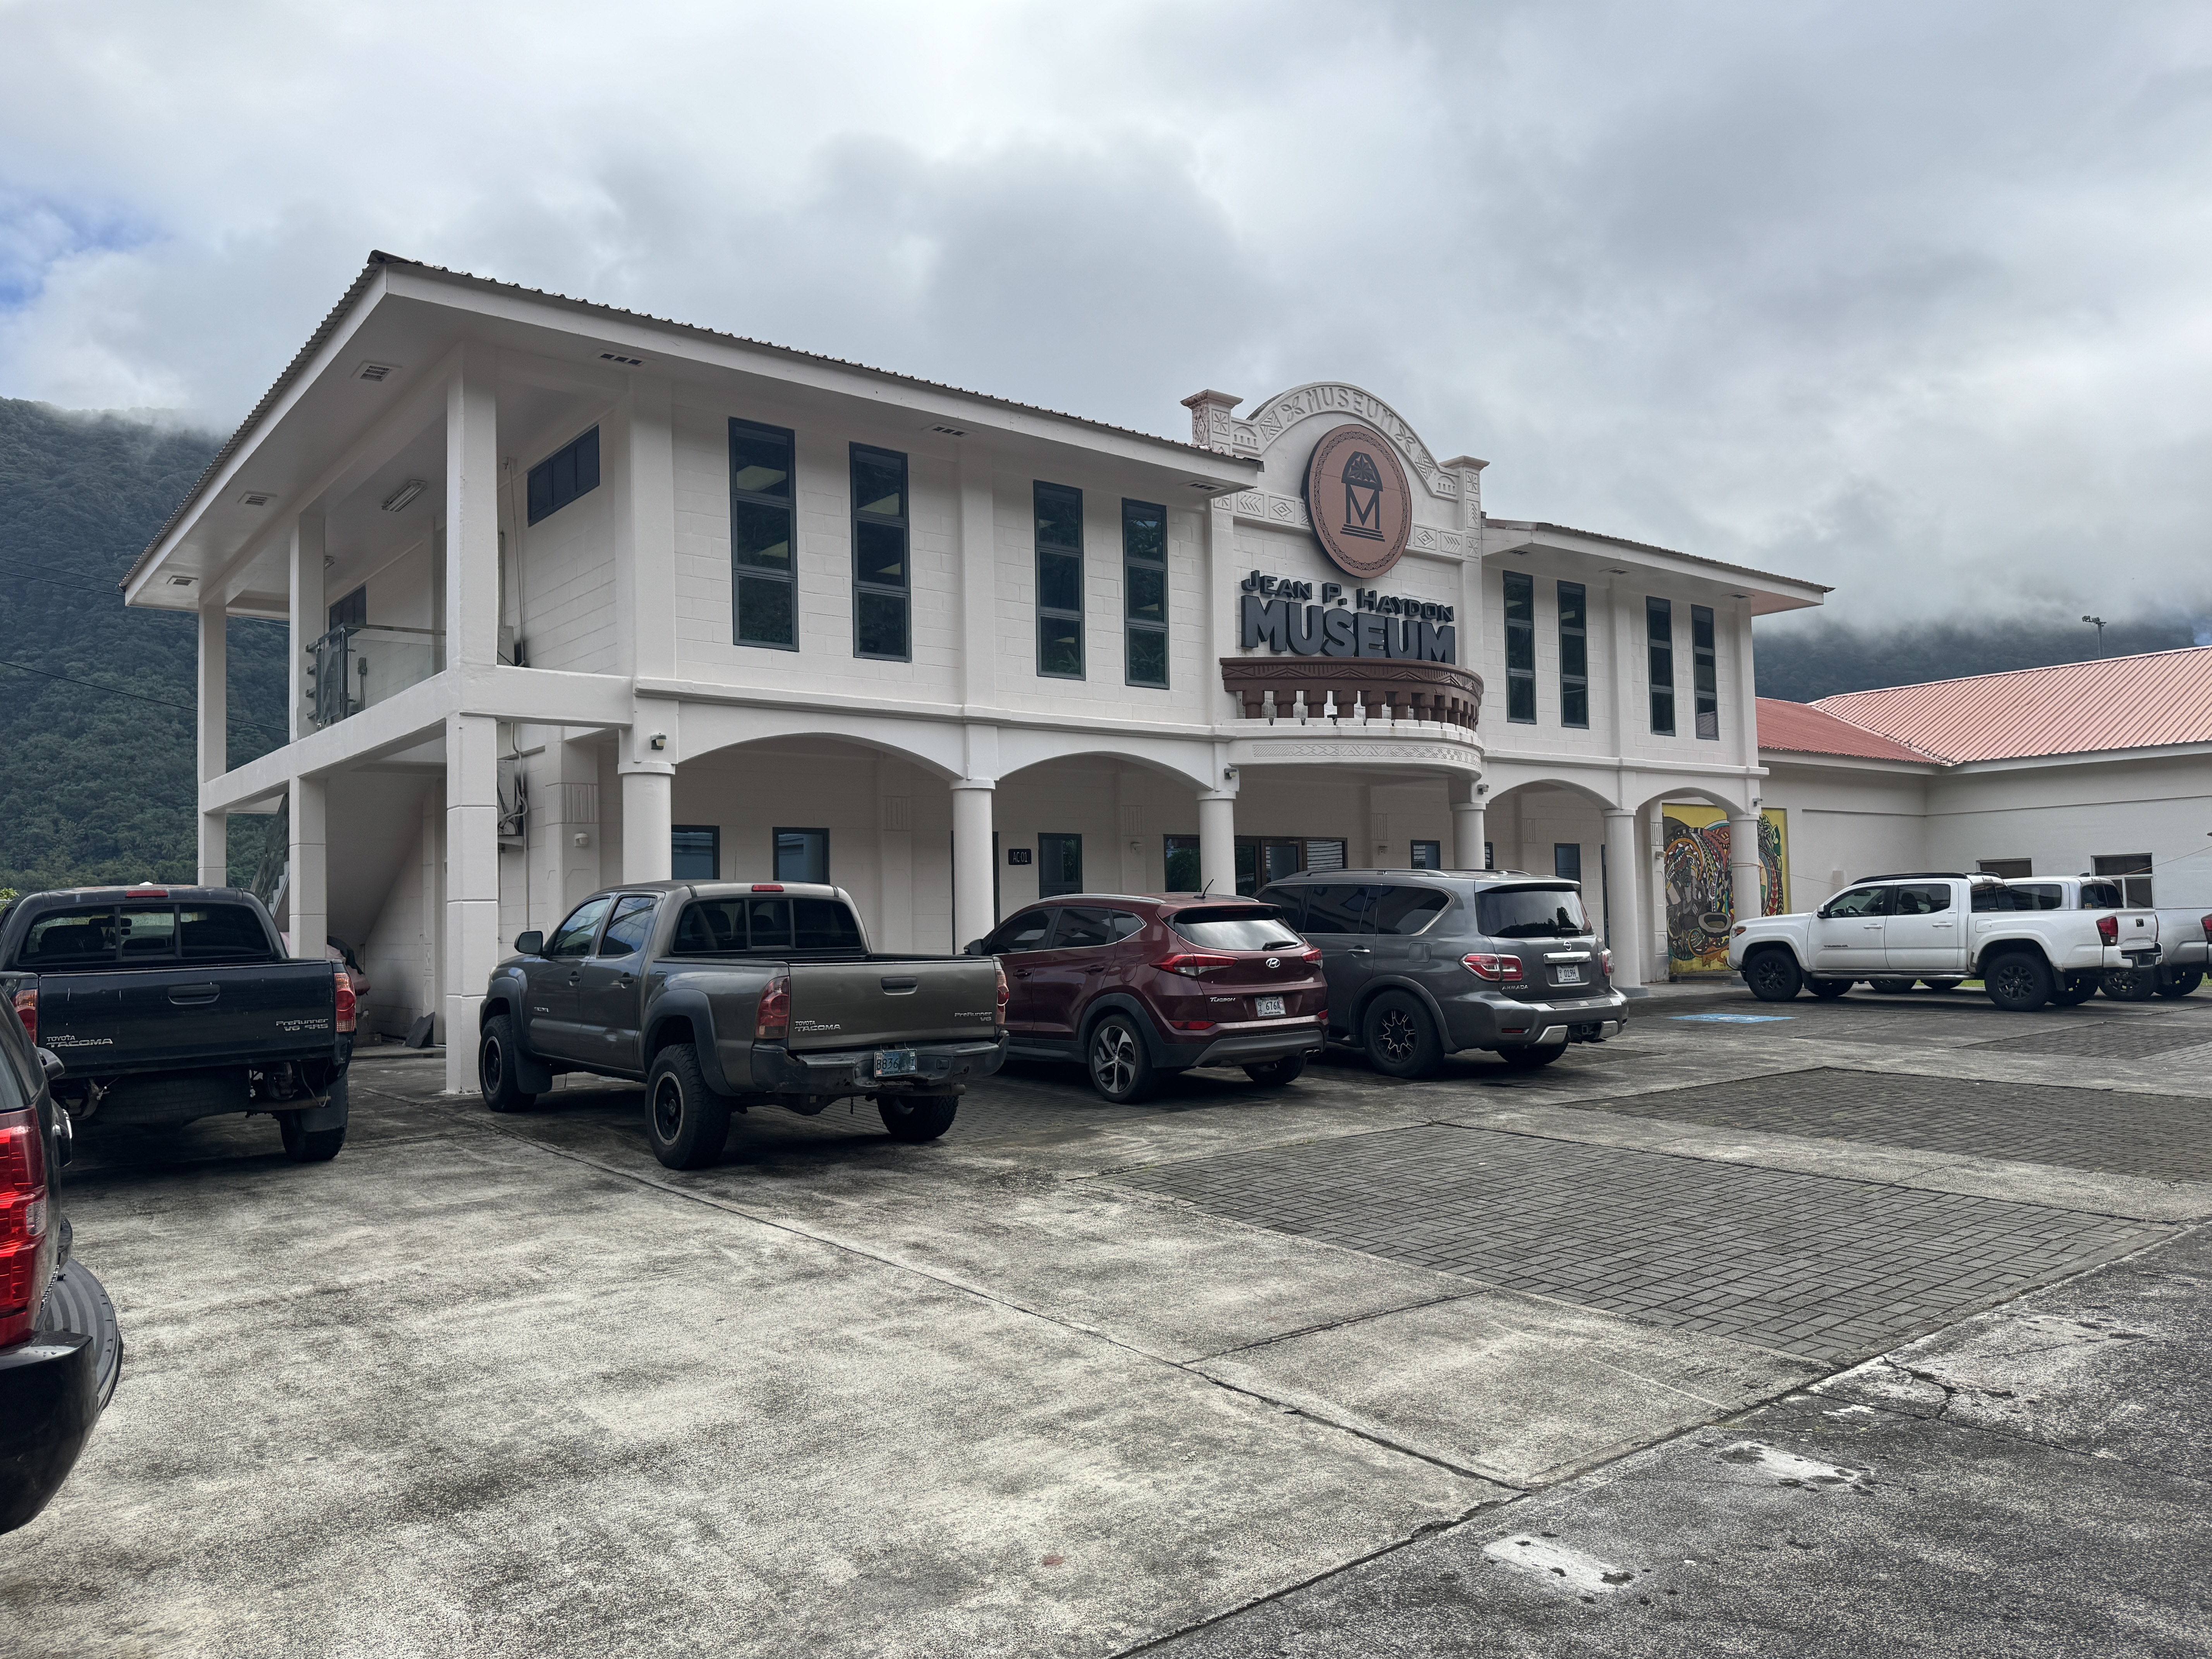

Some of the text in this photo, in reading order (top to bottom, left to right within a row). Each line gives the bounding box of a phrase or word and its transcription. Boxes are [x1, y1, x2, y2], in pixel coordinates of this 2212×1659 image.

[1305, 388, 1394, 433] MUSEUM
[1241, 570, 1454, 622] JEAN P. HAYDON
[1241, 595, 1456, 665] MUSEUM
[46, 1038, 113, 1048] TACOMA
